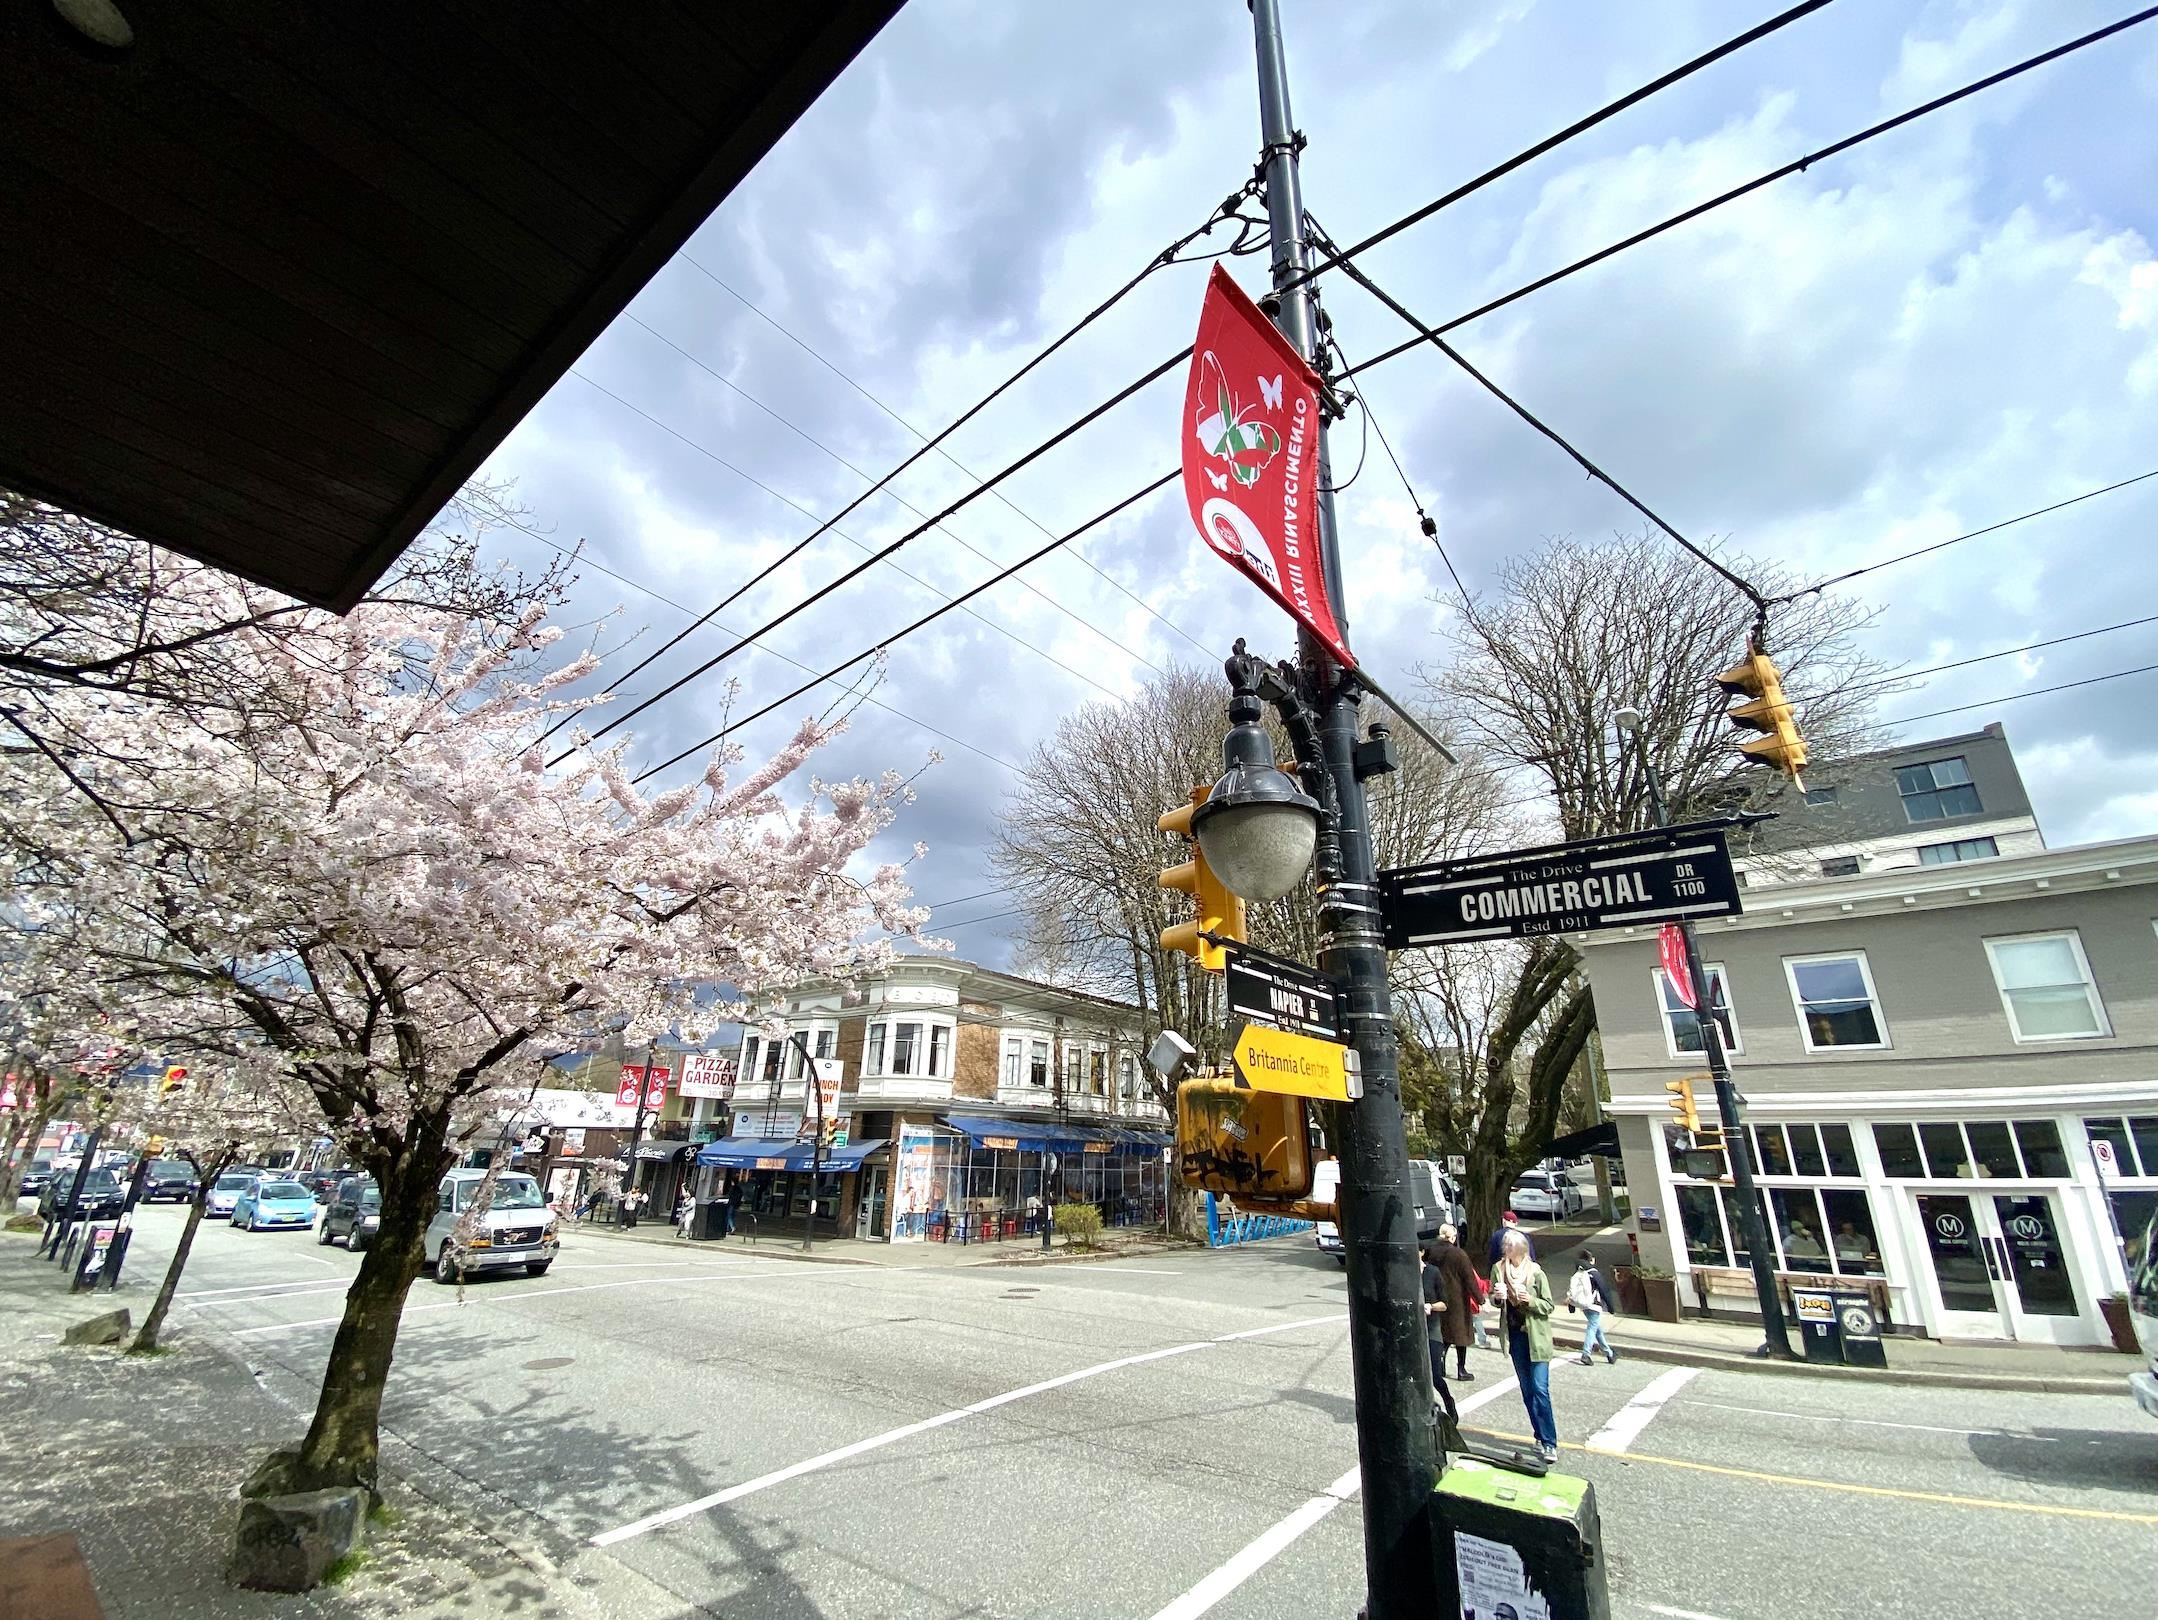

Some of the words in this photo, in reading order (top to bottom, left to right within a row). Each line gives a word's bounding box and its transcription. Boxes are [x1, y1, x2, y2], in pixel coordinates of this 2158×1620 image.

[1509, 870, 1537, 882] The
[1542, 864, 1583, 877] Drive
[1460, 871, 1653, 922] COMMERCIAL
[1675, 863, 1695, 877] DR
[1672, 880, 1706, 897] 1100
[1522, 919, 1551, 934] Estd
[1560, 915, 1589, 930] 1911
[1270, 987, 1304, 1018] NAPIER
[694, 1057, 731, 1073] PIZZA
[1249, 1047, 1298, 1074] Britannia
[1300, 1056, 1330, 1080] Centre
[685, 1070, 736, 1087] GARDEN
[1941, 1218, 1958, 1233] M
[2019, 1219, 2037, 1235] M
